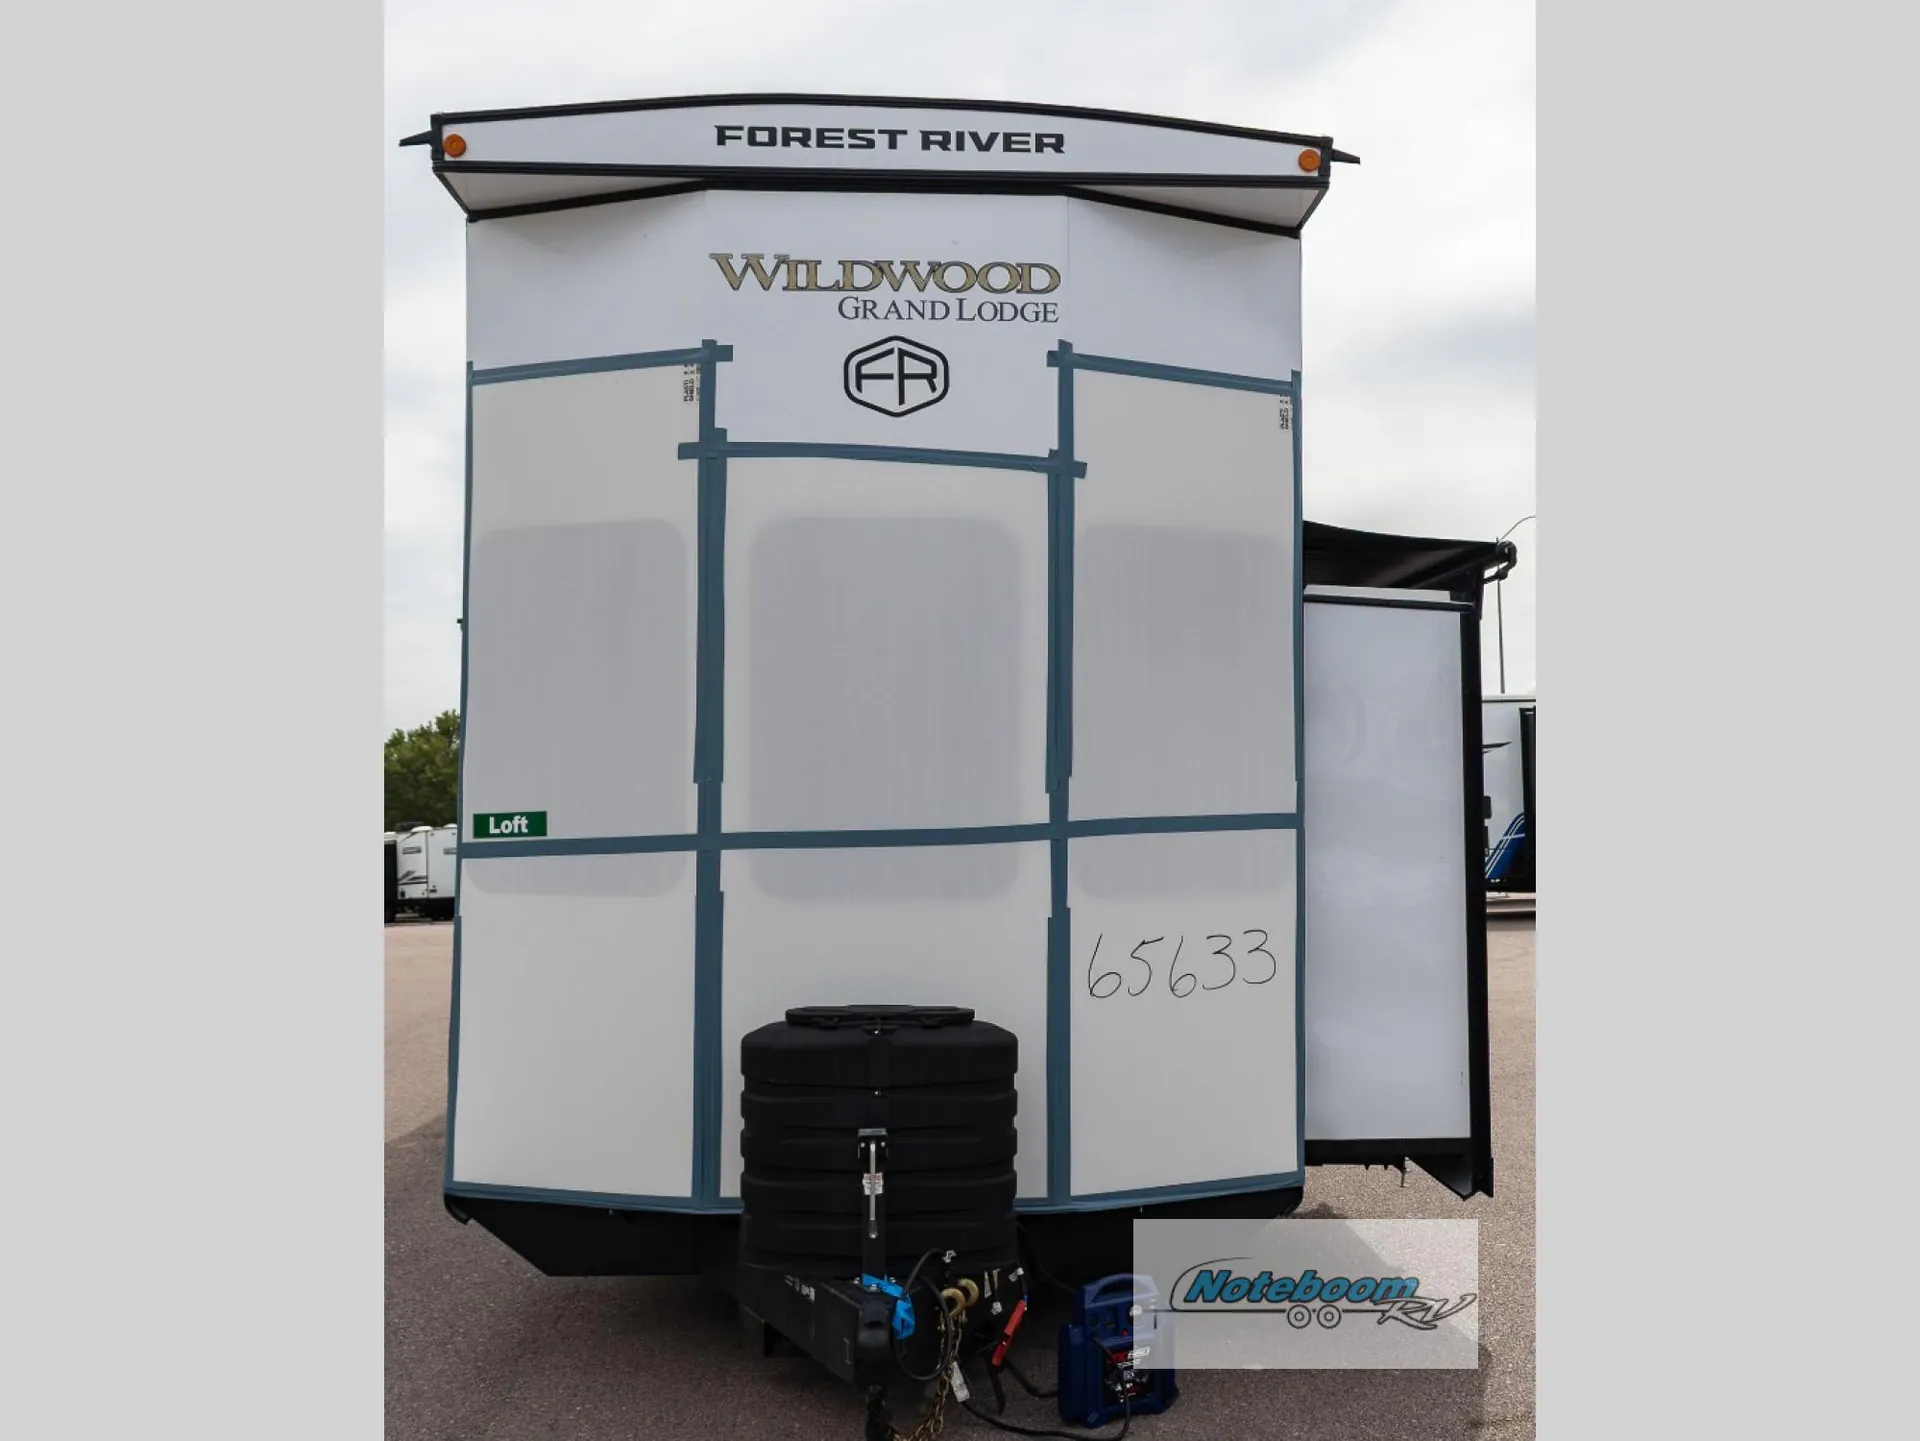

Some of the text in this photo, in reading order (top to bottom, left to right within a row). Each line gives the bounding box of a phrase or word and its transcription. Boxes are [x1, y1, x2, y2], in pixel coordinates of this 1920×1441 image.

[714, 124, 1065, 155] FOREST RIVER
[709, 252, 1061, 295] WILDWOOD
[838, 296, 1060, 324] GRAND LODGE
[855, 346, 938, 406] FR
[489, 815, 529, 834] Loft
[1088, 929, 1277, 999] 65633
